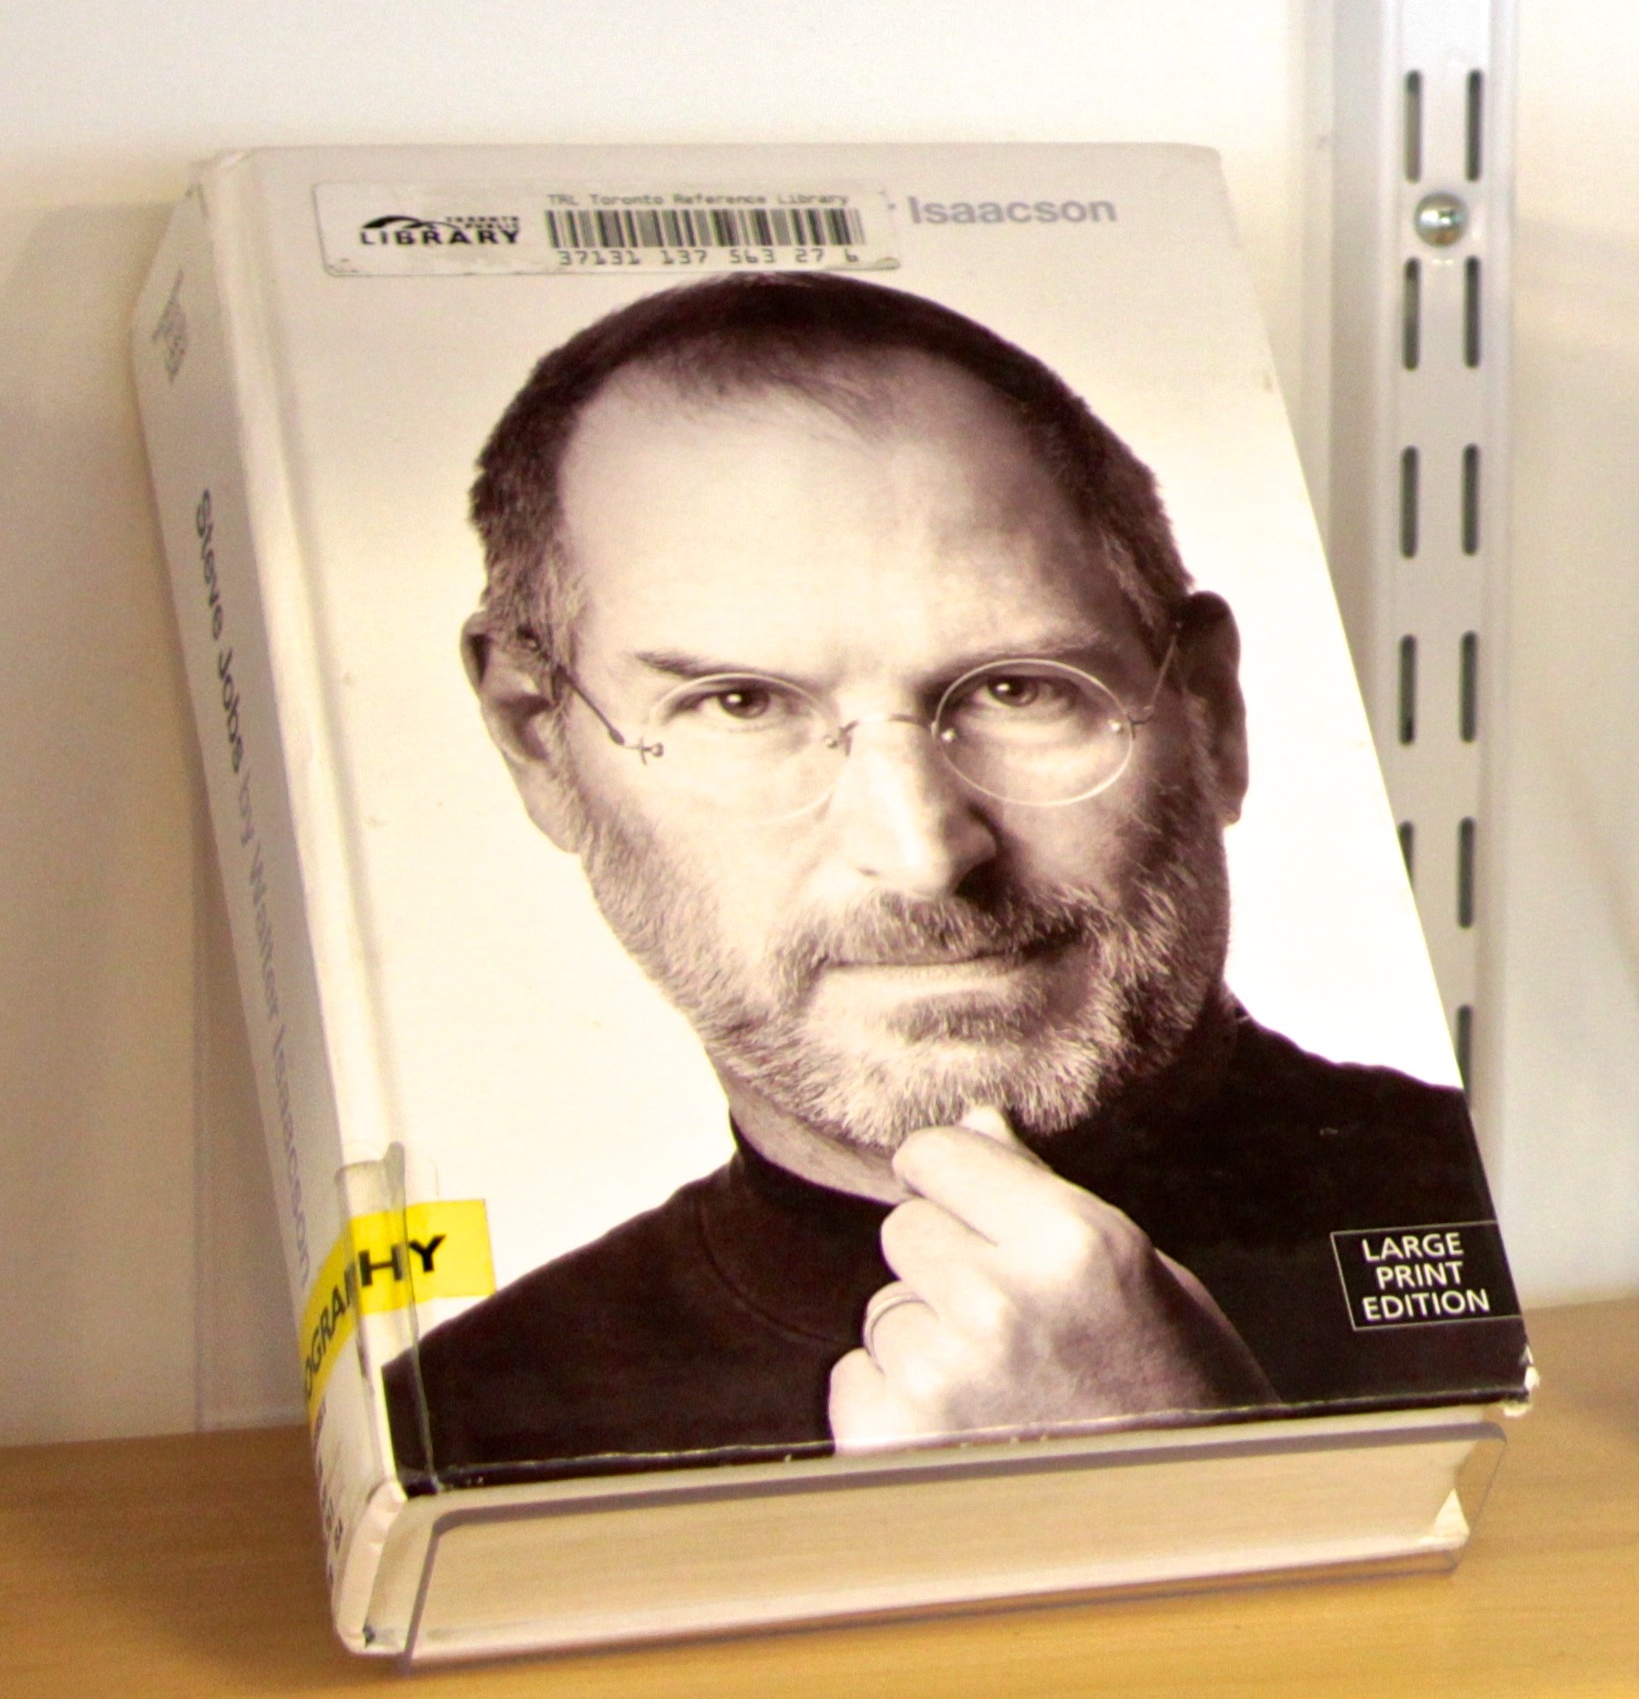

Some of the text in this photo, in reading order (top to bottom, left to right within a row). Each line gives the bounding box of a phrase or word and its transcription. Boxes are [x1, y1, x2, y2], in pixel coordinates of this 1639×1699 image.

[359, 229, 521, 246] LIBRARY
[558, 248, 776, 266] 37131 137 563
[1361, 1231, 1464, 1263] LARGE
[1375, 1261, 1464, 1291] PRINT
[1361, 1288, 1491, 1322] EDITION
